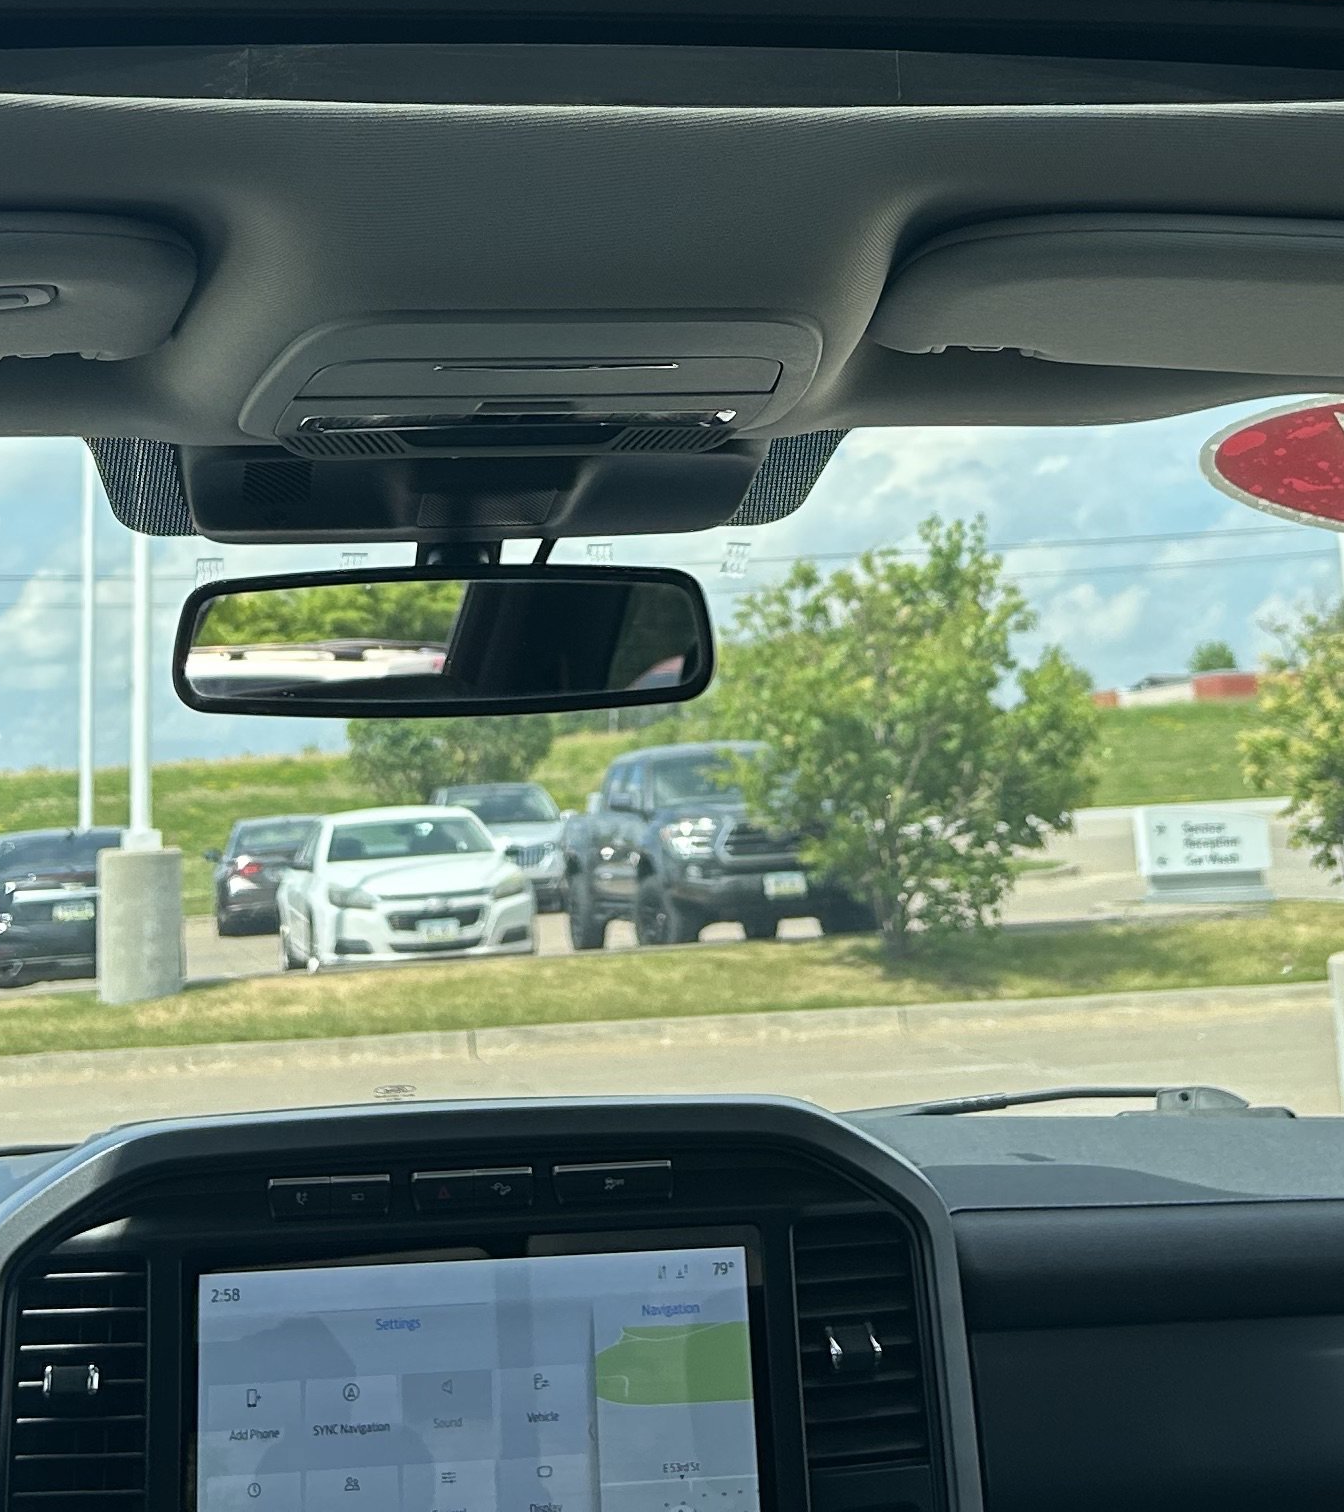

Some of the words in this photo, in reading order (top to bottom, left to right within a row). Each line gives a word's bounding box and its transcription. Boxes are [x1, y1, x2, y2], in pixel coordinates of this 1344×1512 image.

[211, 1288, 240, 1302] 2:58
[641, 1303, 700, 1317] Navigation
[375, 1318, 421, 1331] Settings
[433, 1417, 463, 1429] Sound
[526, 1411, 560, 1424] Vehicle
[229, 1430, 248, 1441] Add
[250, 1428, 279, 1440] Phone
[313, 1424, 338, 1436] SYNC
[340, 1422, 390, 1435] Navigation
